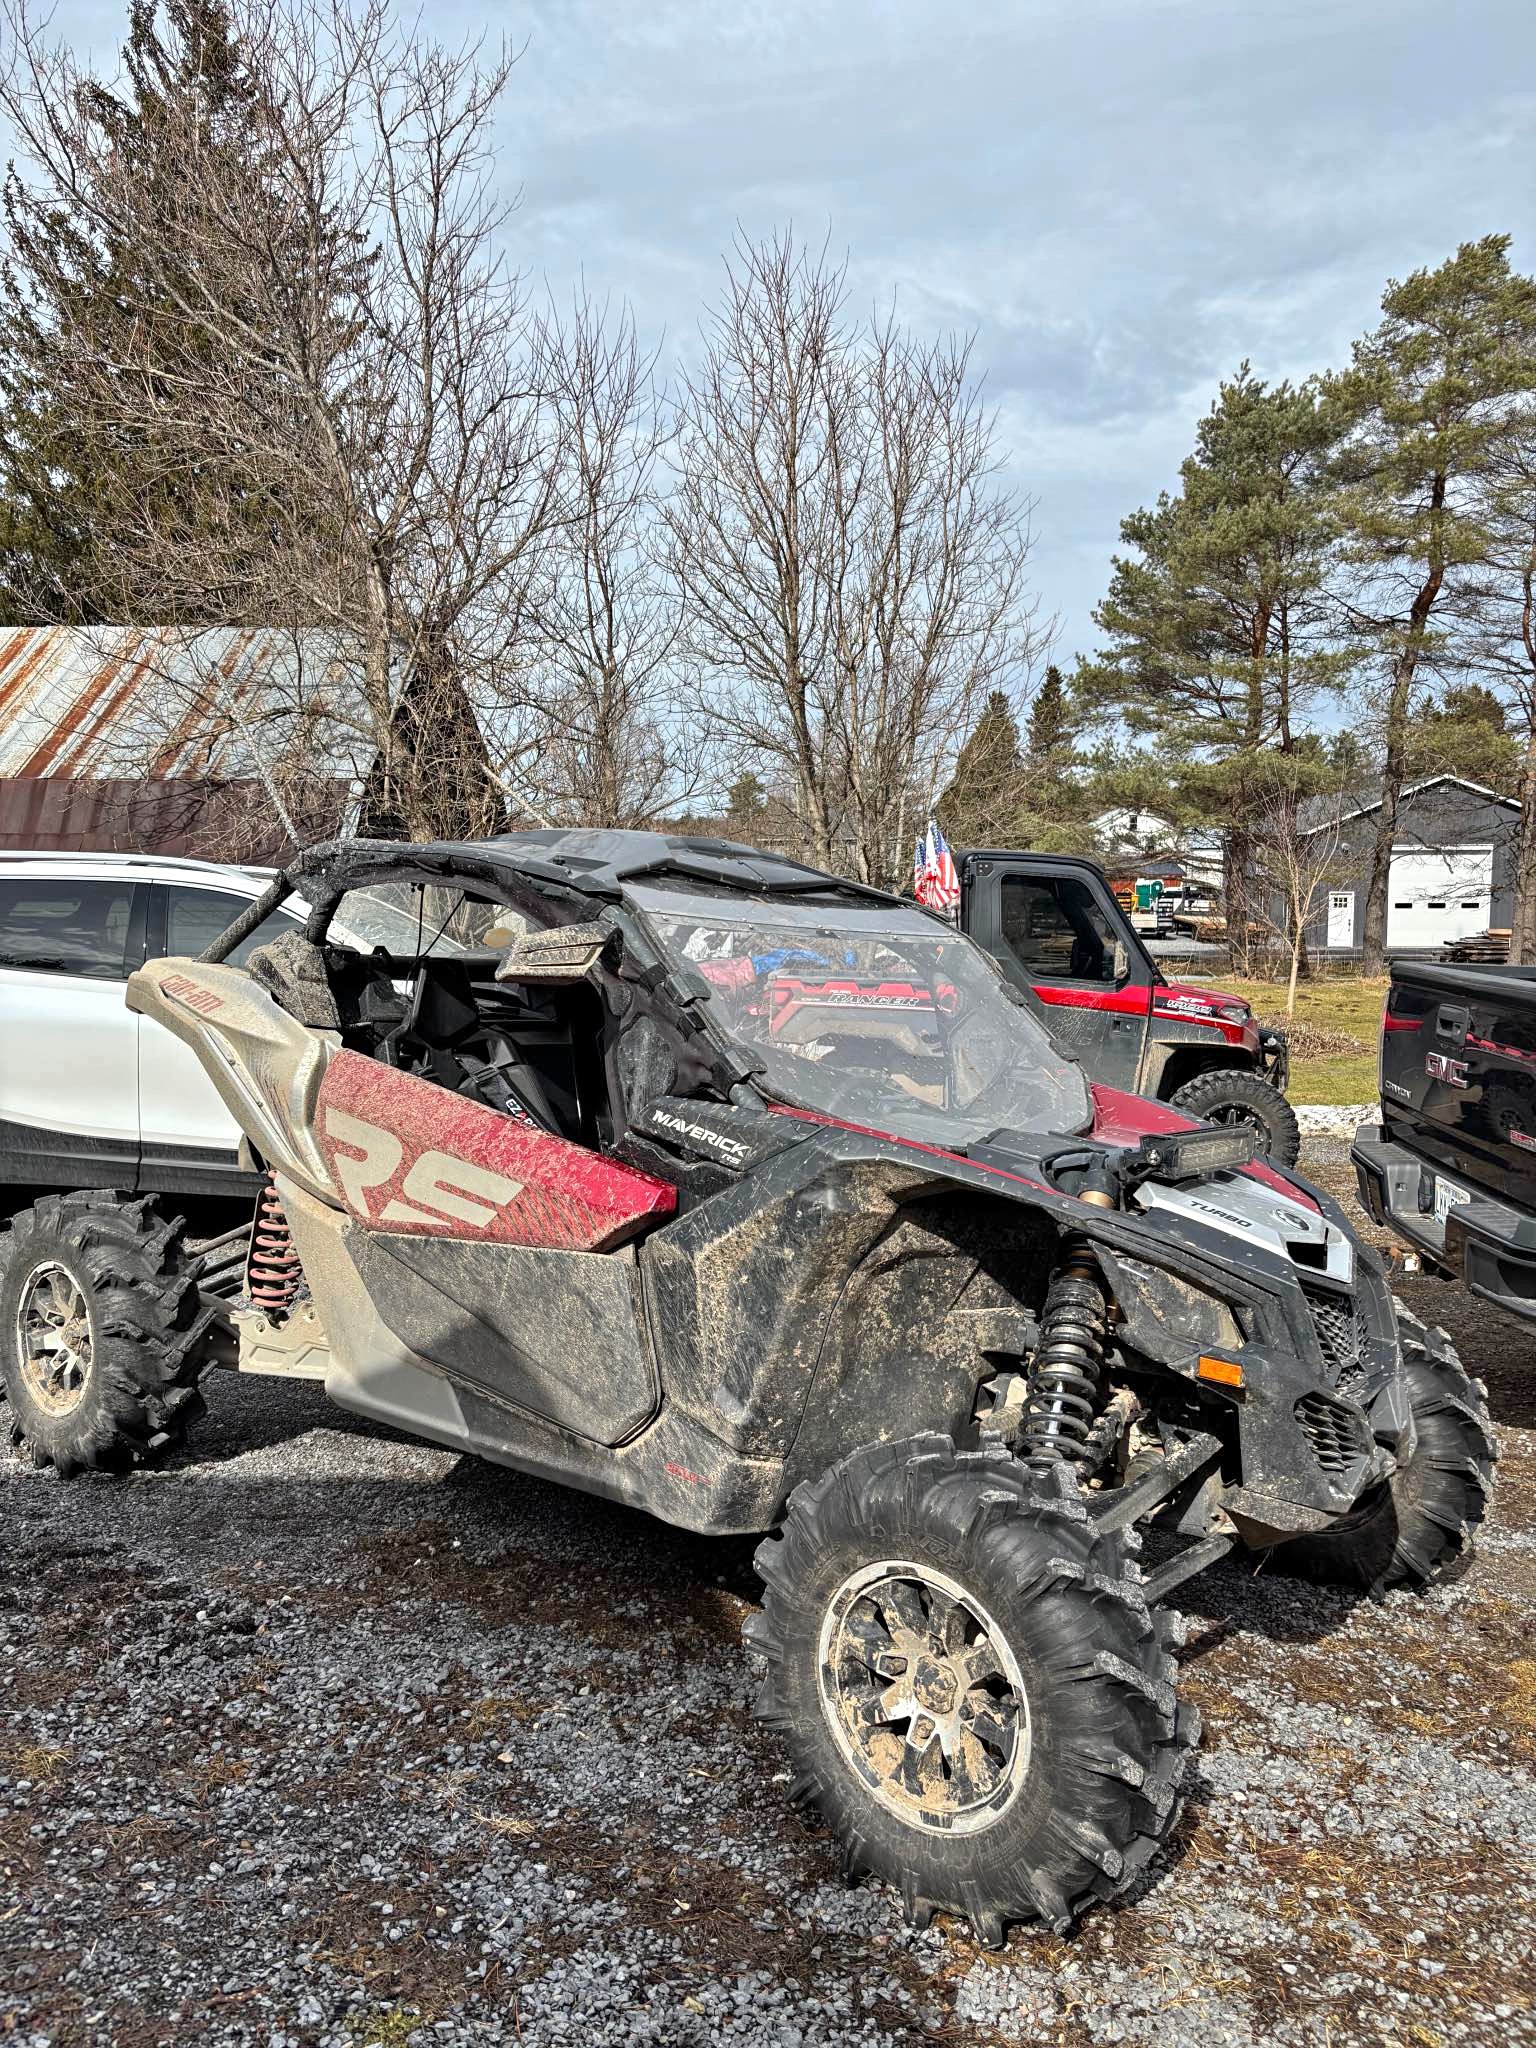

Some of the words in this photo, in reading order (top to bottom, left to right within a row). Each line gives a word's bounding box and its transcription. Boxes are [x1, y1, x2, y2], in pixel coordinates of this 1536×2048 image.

[1425, 1052, 1469, 1089] GMC
[652, 1109, 751, 1158] MAVERICK
[720, 1153, 742, 1165] RS
[1191, 1201, 1253, 1228] TURBO
